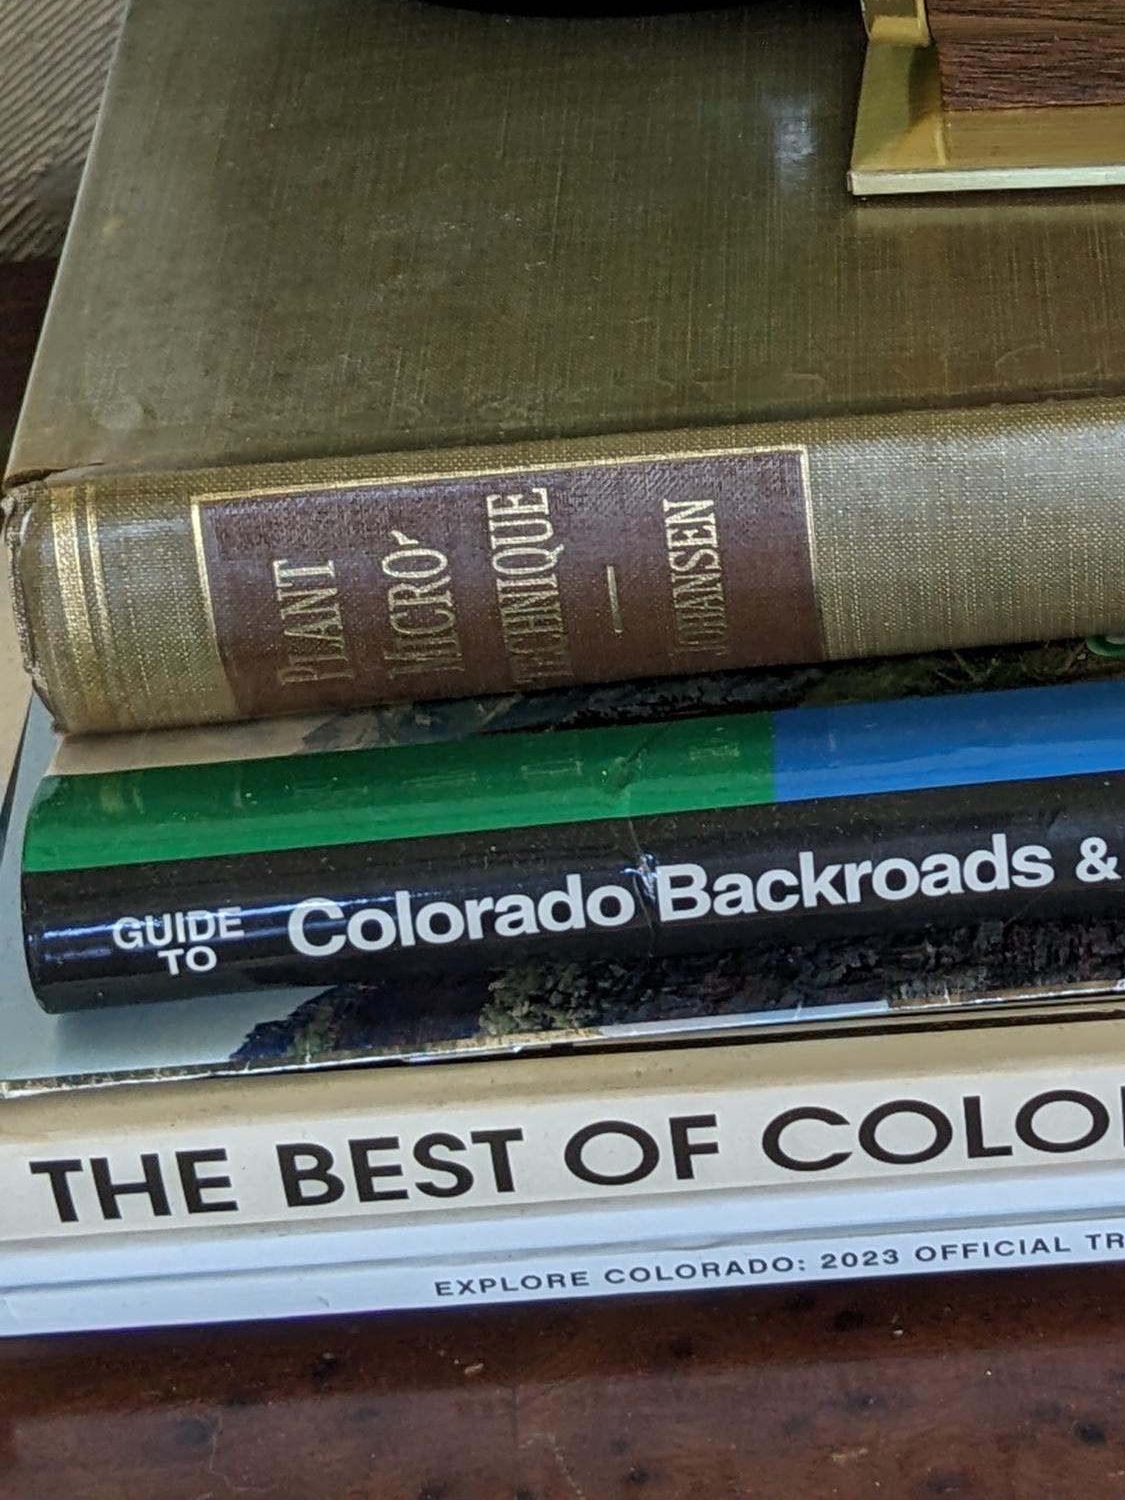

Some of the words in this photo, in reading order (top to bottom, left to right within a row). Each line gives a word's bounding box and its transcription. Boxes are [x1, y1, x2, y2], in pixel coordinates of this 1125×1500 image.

[272, 558, 355, 686] PLANT
[486, 486, 575, 684] TECHNIQUE
[662, 498, 731, 657] JOHANSEN
[112, 906, 245, 951] GUIDE
[287, 873, 637, 958] Colorado
[654, 832, 1055, 924] Backroads
[1075, 836, 1122, 884] &
[158, 945, 219, 976] TO
[30, 1147, 240, 1223] THE
[276, 1127, 525, 1208] BEST
[563, 1113, 720, 1187] OF
[434, 1269, 591, 1298] EXPLORE
[602, 1255, 806, 1288] COLORADO:
[819, 1247, 901, 1271] 2023
[914, 1236, 1073, 1263] OFFICIAL
